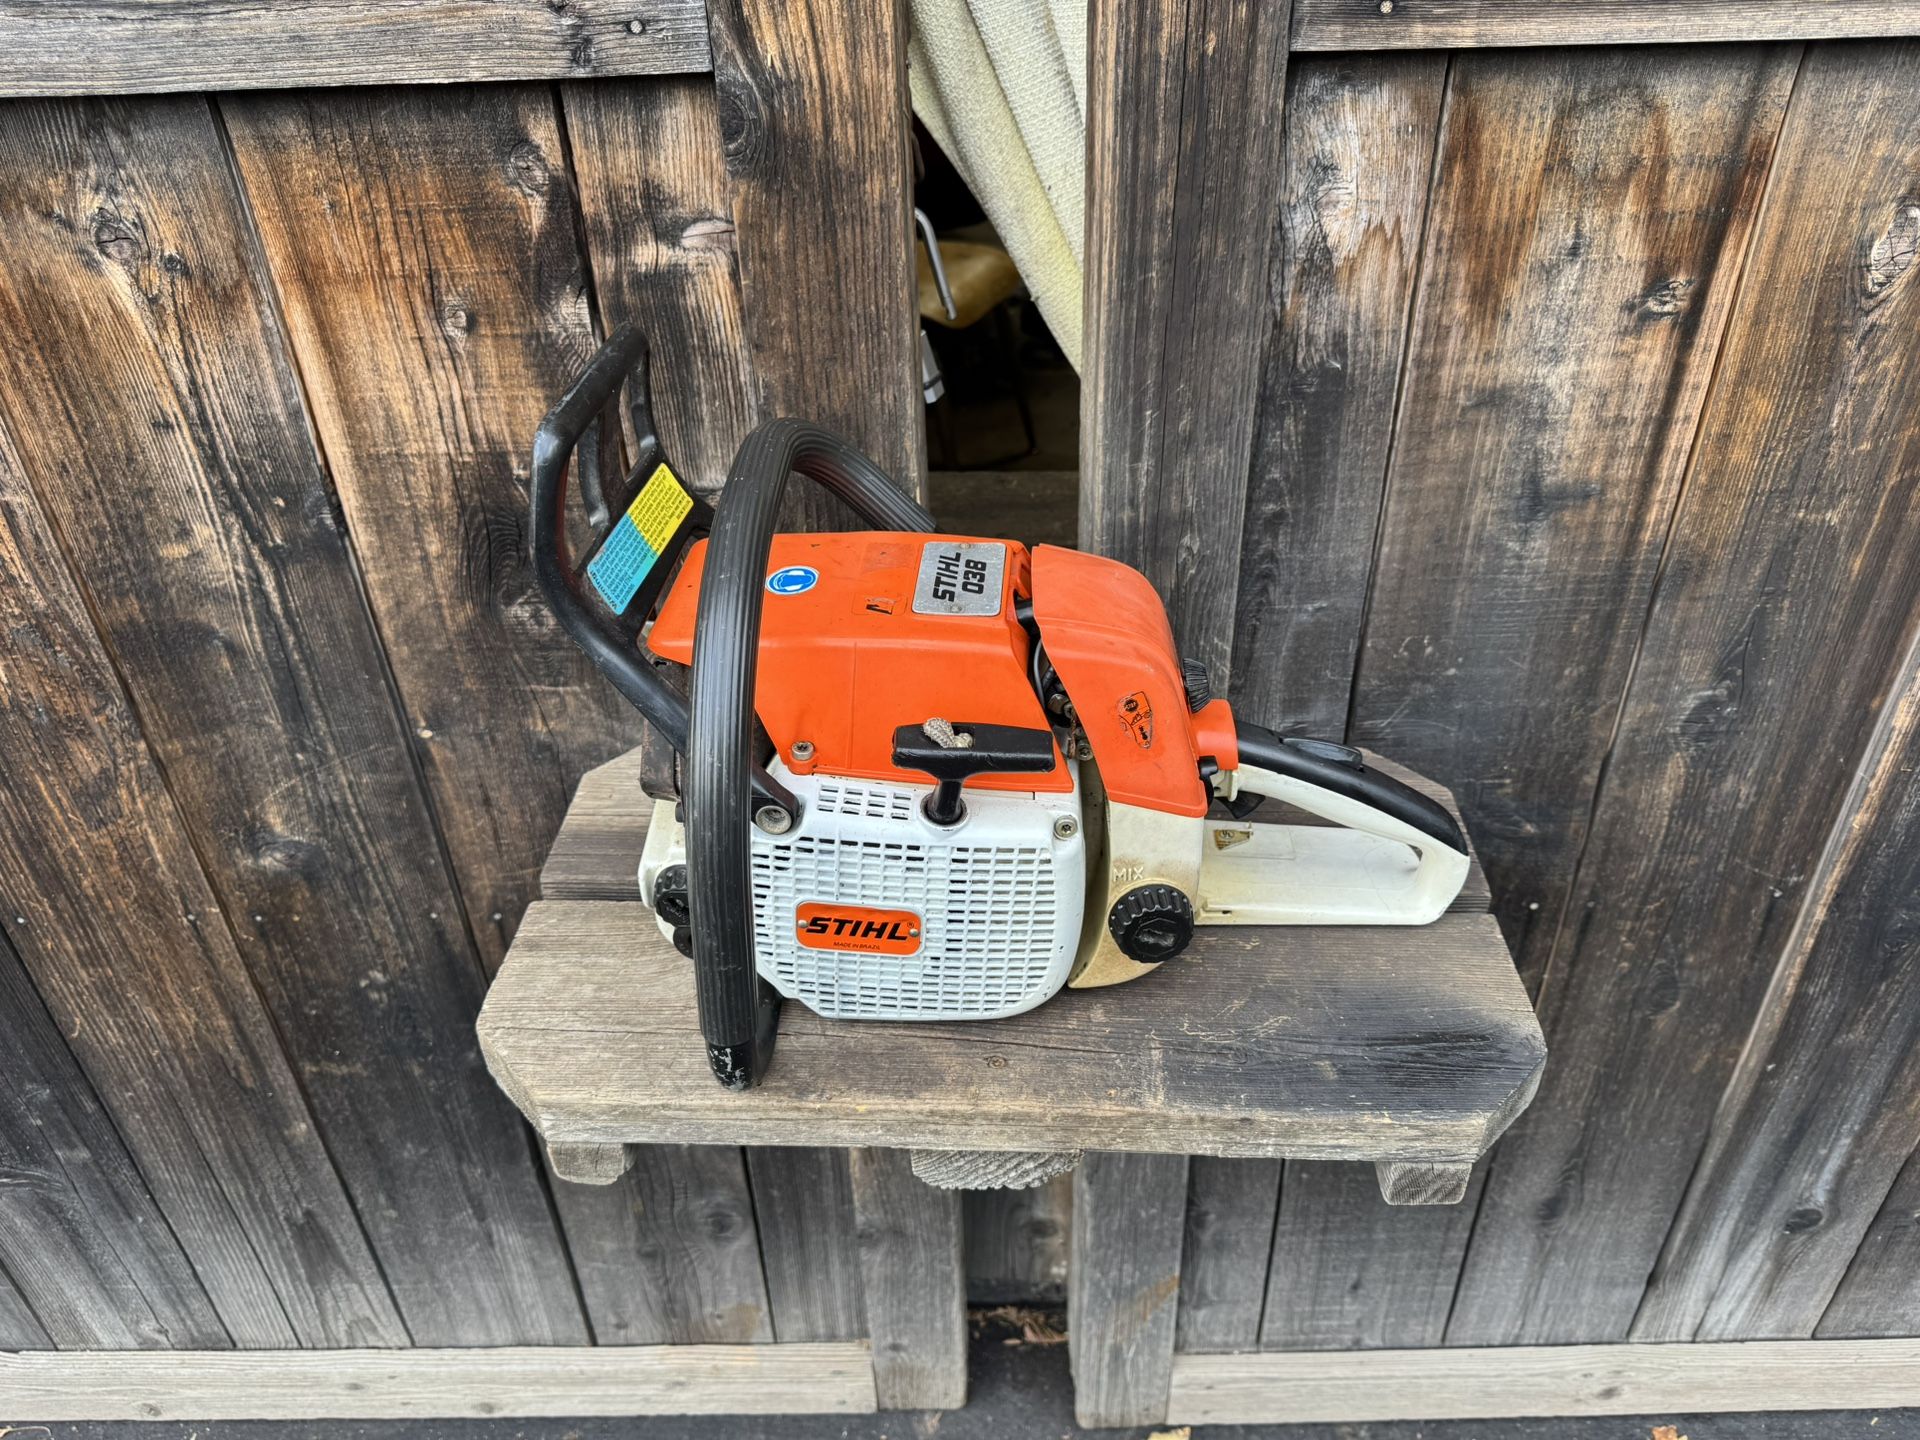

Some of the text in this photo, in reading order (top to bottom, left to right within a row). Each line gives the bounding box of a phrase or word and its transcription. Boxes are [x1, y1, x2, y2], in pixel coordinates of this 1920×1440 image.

[933, 552, 961, 602] STIHL
[962, 559, 987, 594] 038
[1113, 866, 1144, 882] MIX
[806, 916, 908, 941] STIHL
